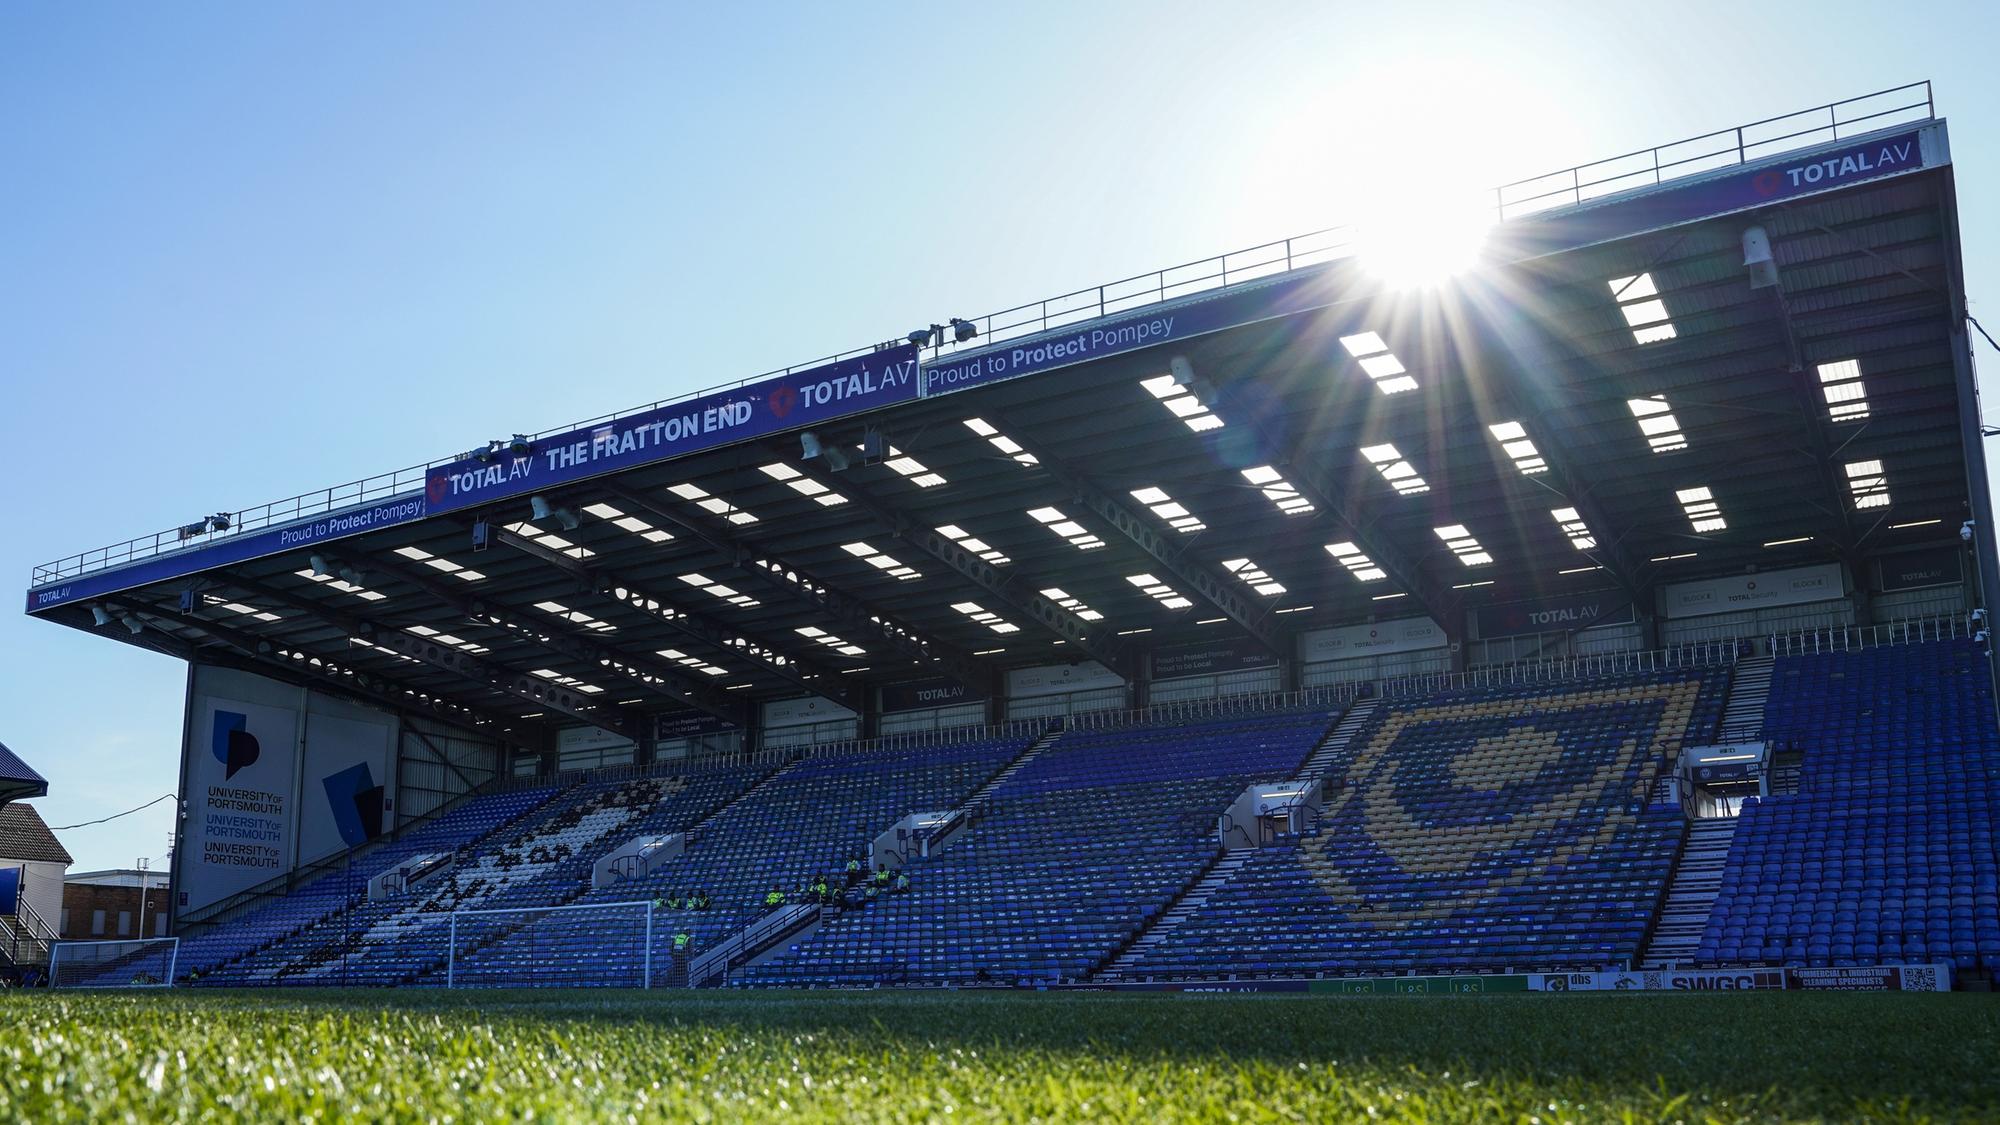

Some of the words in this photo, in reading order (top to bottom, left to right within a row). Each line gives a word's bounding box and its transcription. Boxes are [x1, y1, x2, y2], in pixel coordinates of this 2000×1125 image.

[1787, 152, 1873, 187] TOTAL
[1877, 141, 1911, 168] AV
[928, 361, 981, 387] Proud
[987, 357, 1006, 372] to
[1012, 334, 1086, 368] Protect
[1092, 316, 1174, 349] Pompey
[800, 370, 876, 408] TOTAL
[880, 362, 914, 388] AV
[546, 443, 589, 471] THE
[591, 413, 699, 460] FRATTON
[703, 400, 753, 432] END
[450, 463, 506, 495] TOTAL
[509, 455, 533, 481] AV
[281, 524, 312, 545] Proud
[314, 523, 327, 540] to
[329, 512, 372, 534] Protect
[374, 499, 421, 524] Pompey
[1529, 608, 1577, 624] TOTAL
[1580, 605, 1599, 619] AV
[917, 687, 950, 701] TOTAL
[951, 685, 964, 696] AV
[208, 785, 273, 803] UNIVERSITY
[207, 797, 282, 815] PORTSMOUTH
[206, 814, 272, 828] UNIVERSITY
[271, 822, 282, 830] OF
[206, 825, 281, 841] PORTSMOUTH
[204, 841, 270, 856] UNIVERSITY
[270, 849, 280, 857] OF
[204, 853, 279, 869] PORTSMOUTH
[1571, 974, 1591, 985] dbs
[1792, 968, 1841, 978] COMMERCIAL
[1849, 968, 1891, 977] INDUSTRIAL
[1803, 978, 1837, 986] CLEANING
[1838, 977, 1884, 985] SPECIALISTS
[1672, 976, 1753, 991] SWGC
